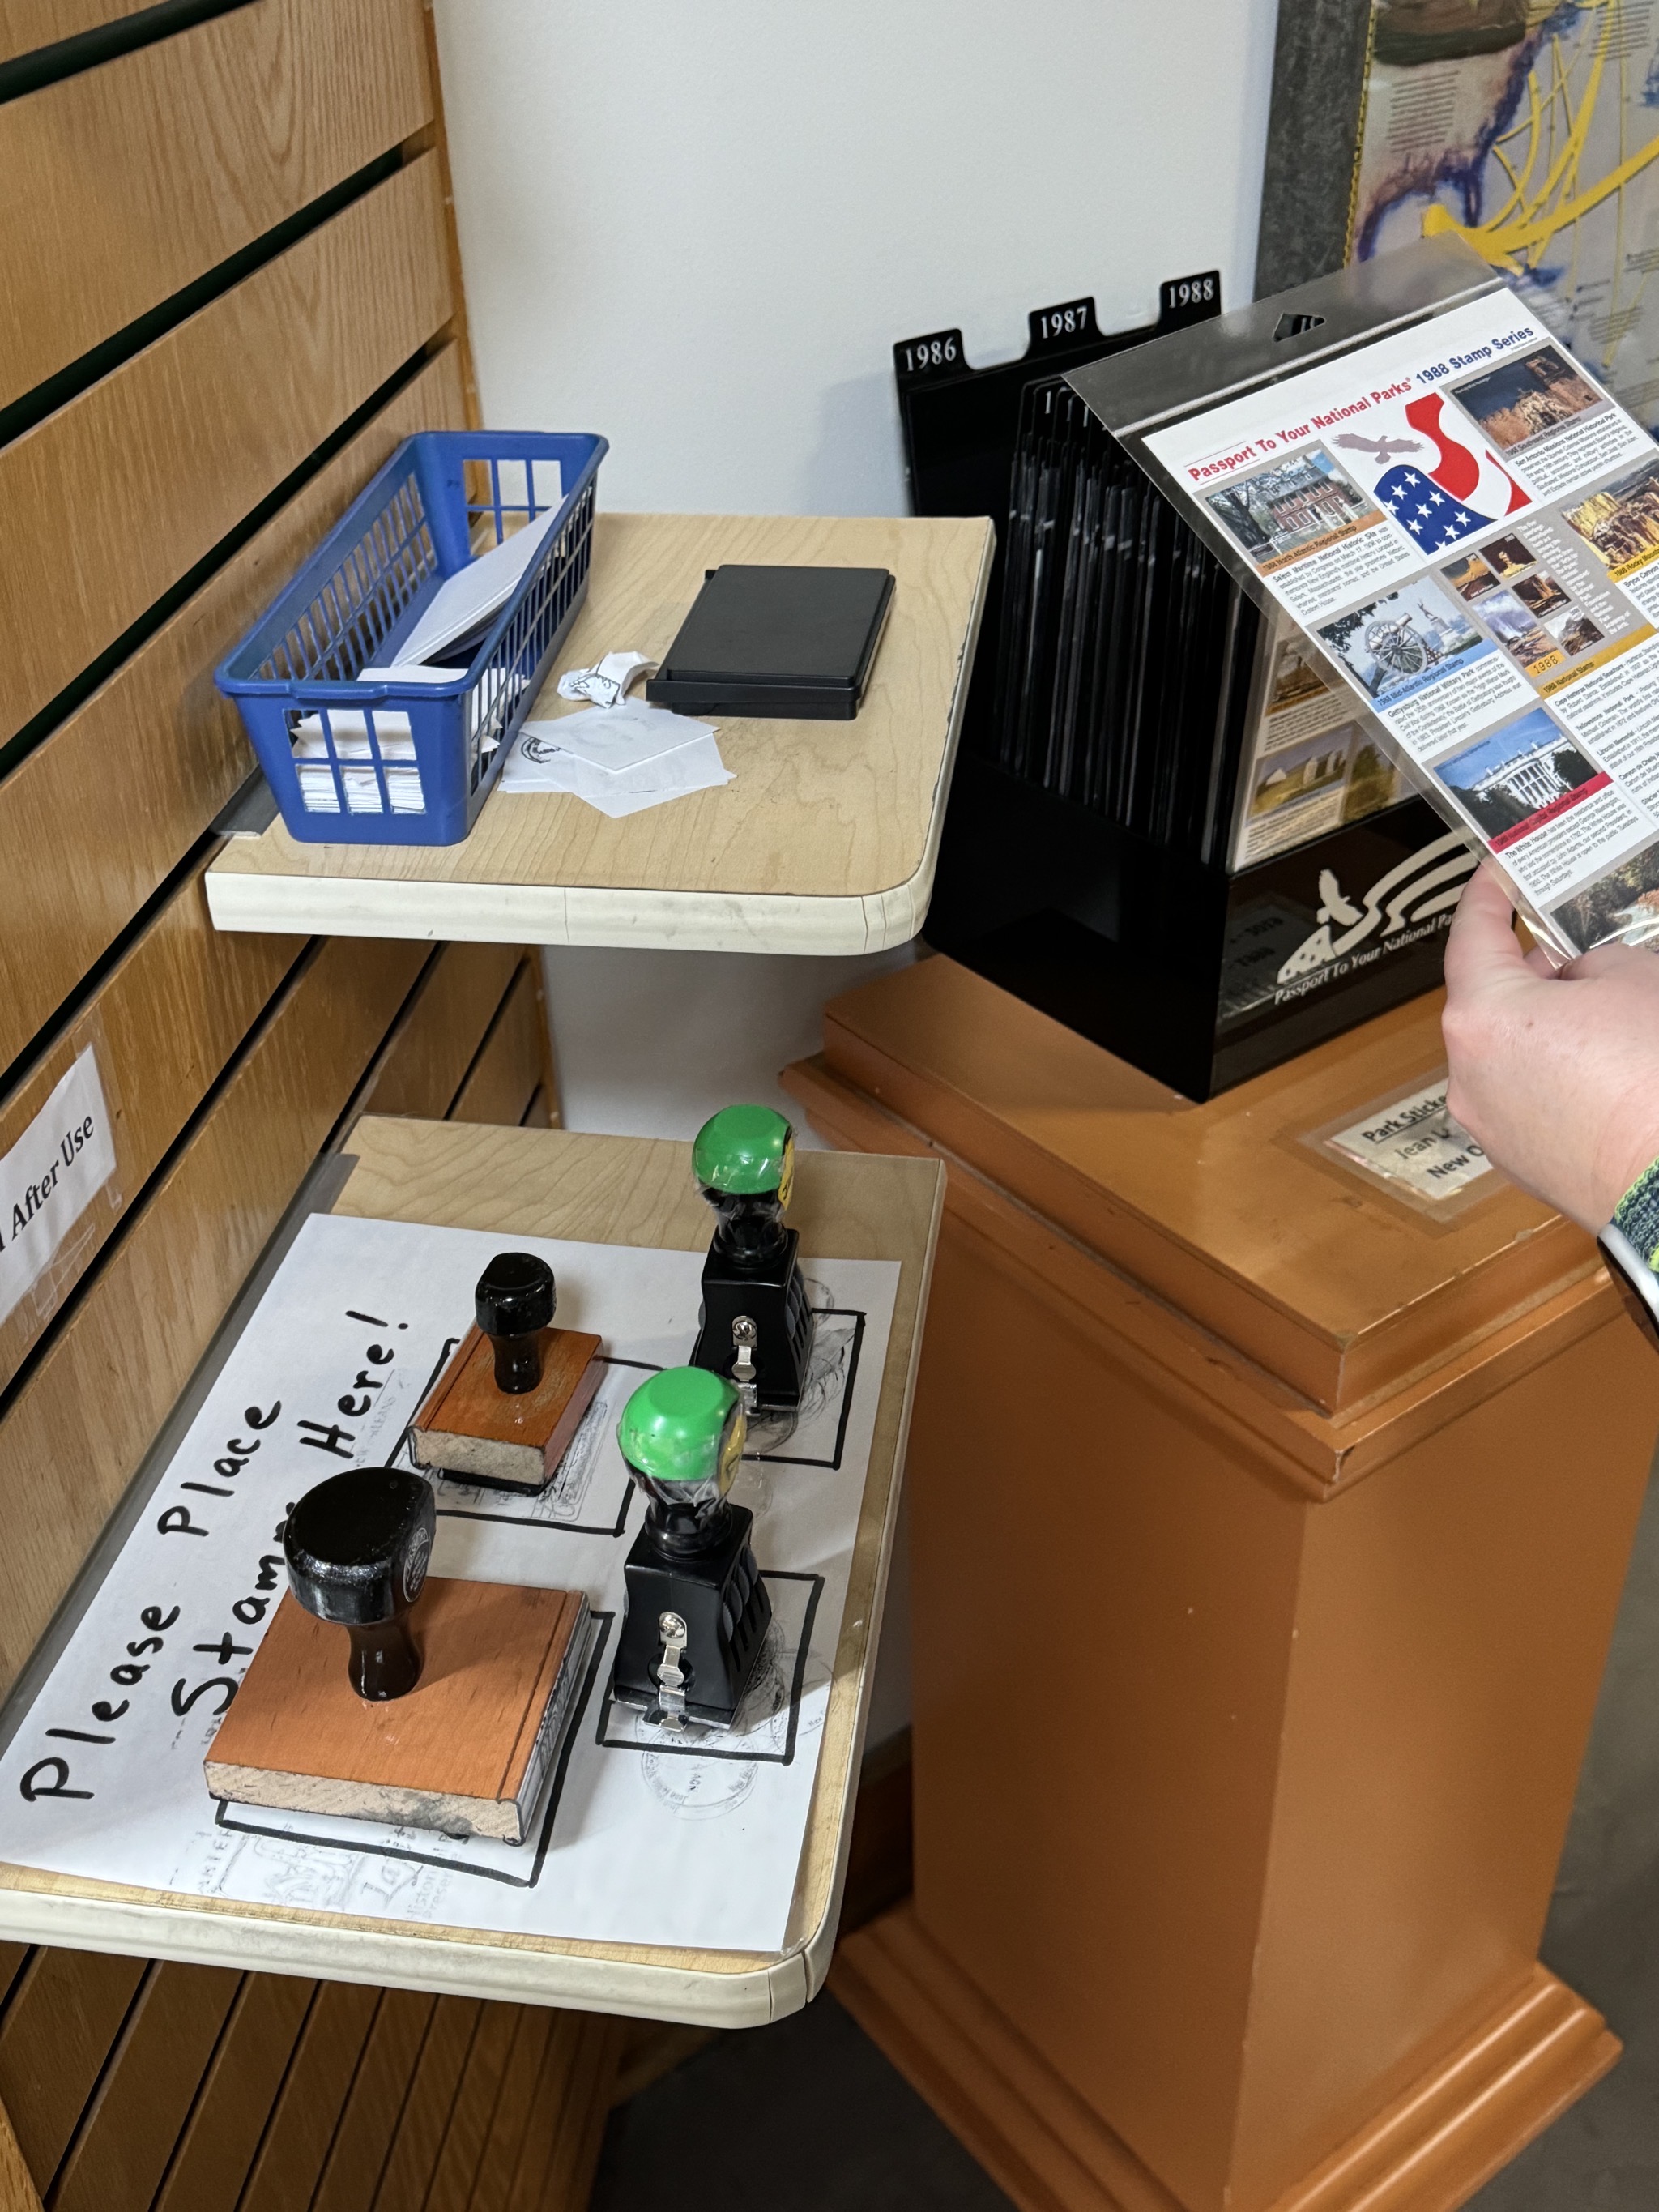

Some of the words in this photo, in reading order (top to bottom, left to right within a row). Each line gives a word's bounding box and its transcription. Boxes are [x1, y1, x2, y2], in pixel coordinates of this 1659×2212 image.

[1167, 278, 1215, 309] 1988
[1040, 305, 1088, 339] 1987
[905, 335, 957, 372] 1986
[1188, 445, 1257, 480] Passport
[1254, 438, 1277, 452] To
[1275, 424, 1313, 443] Your
[1310, 396, 1371, 429] National
[1370, 382, 1412, 404] Parks
[1414, 362, 1450, 384] 1988
[1448, 346, 1495, 369] Stamp
[1491, 327, 1533, 349] Series
[1605, 412, 1615, 421] Park
[1273, 572, 1290, 582] Salem
[1318, 548, 1340, 560] National
[1341, 538, 1363, 549] Historic
[1277, 554, 1293, 564] North
[1293, 545, 1315, 556] Atlantic
[1314, 533, 1338, 546] Regional
[1338, 526, 1357, 535] Stamp
[1624, 577, 1640, 587] Bryce
[1422, 667, 1446, 681] Regional
[1445, 659, 1464, 668] Stamp
[1533, 655, 1559, 674] 1988
[1576, 663, 1594, 673] Stamp
[1418, 686, 1440, 700] National
[1441, 677, 1461, 688] Military
[1461, 668, 1473, 677] Park
[1506, 851, 1516, 859] The
[1516, 842, 1531, 852] White
[1530, 832, 1547, 843] House
[1273, 970, 1328, 1006] Passport
[1332, 963, 1349, 978] To
[1350, 946, 1382, 967] Your
[1382, 920, 1436, 955] National
[1361, 1119, 1402, 1142] Park
[1399, 1095, 1447, 1124] Sticke
[11, 1159, 60, 1241] After
[60, 1115, 95, 1167] Use
[1426, 1154, 1470, 1179] New
[296, 1309, 409, 1459] Here!
[19, 1603, 181, 1804] Please
[157, 1399, 281, 1538] Place
